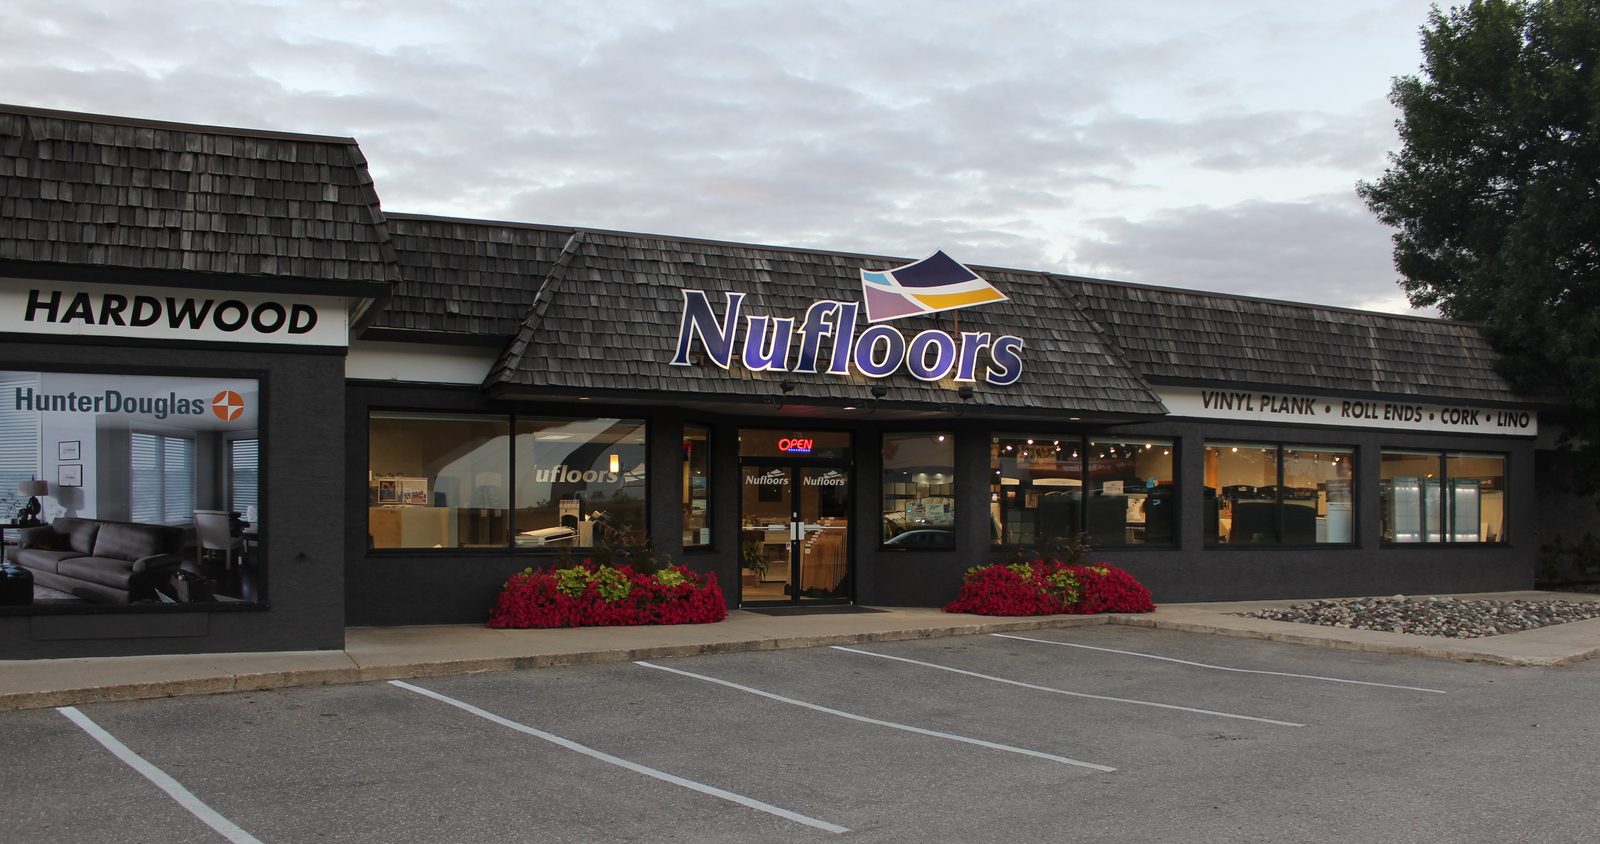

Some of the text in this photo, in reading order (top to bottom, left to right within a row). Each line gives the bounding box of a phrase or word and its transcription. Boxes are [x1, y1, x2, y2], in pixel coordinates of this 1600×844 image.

[24, 289, 319, 334] HARDWOOD
[668, 288, 1024, 386] Nufloors
[1201, 390, 1531, 429] VINYL PLANK ROLL ENDS CORK LINO
[778, 437, 813, 451] OPEN
[534, 464, 619, 483] ufloors
[745, 475, 789, 486] Nufloors
[803, 476, 845, 487] Nufloors
